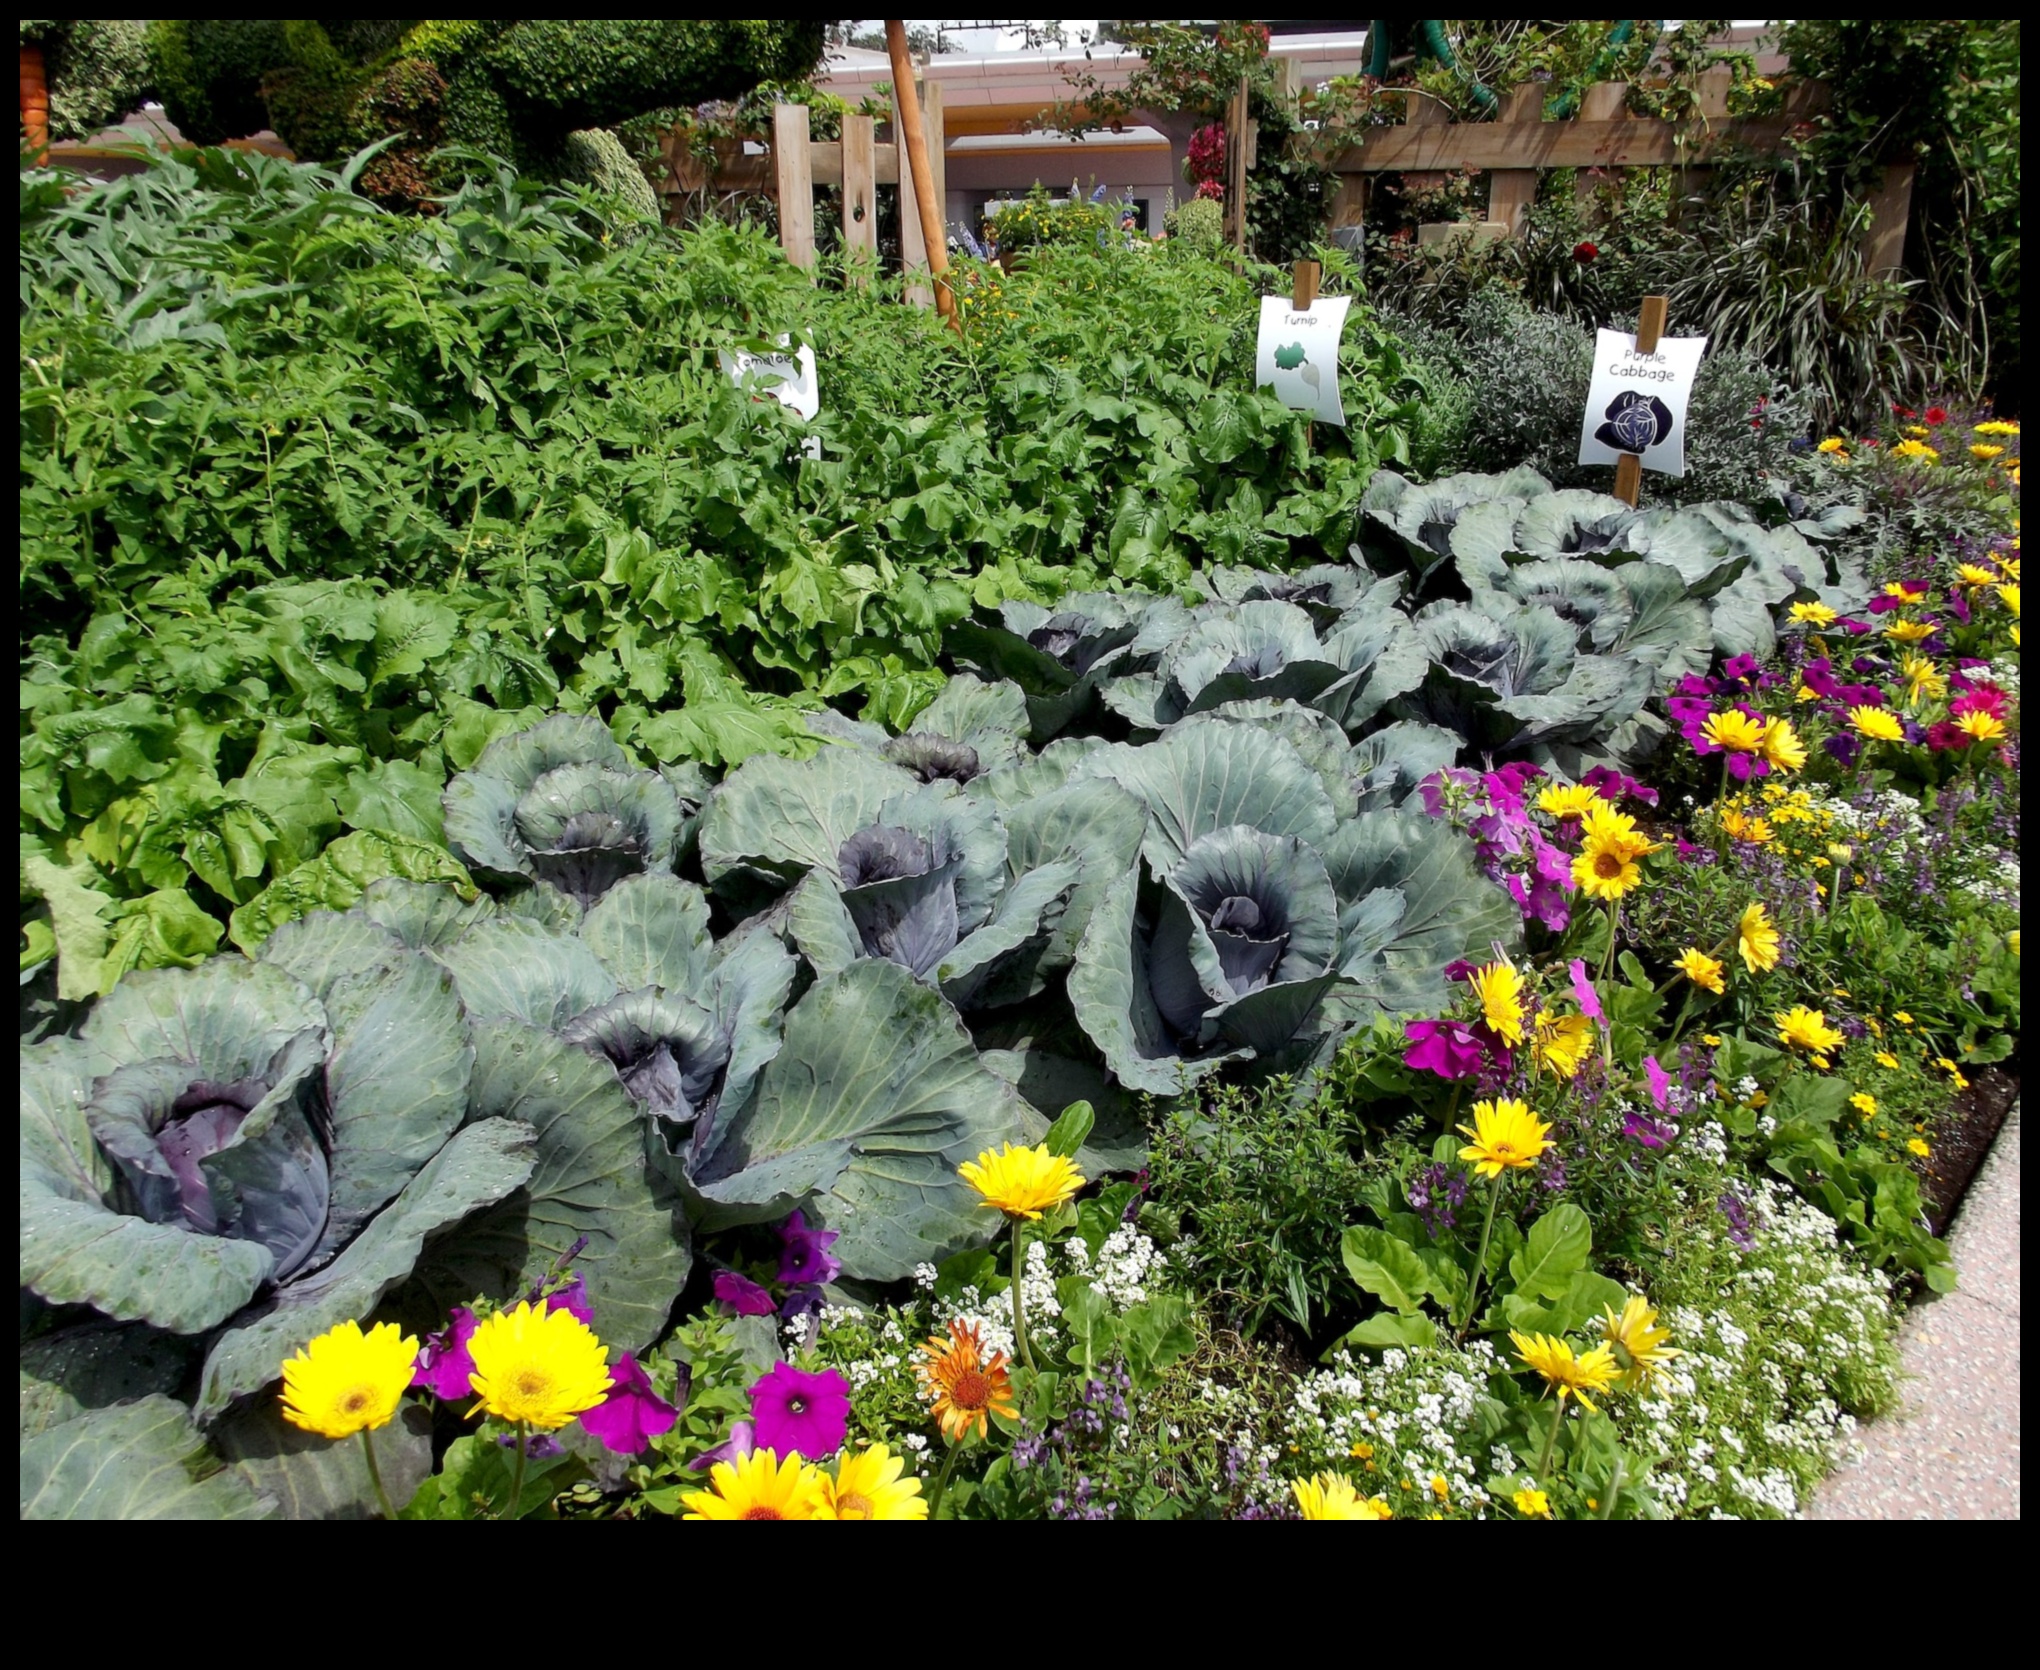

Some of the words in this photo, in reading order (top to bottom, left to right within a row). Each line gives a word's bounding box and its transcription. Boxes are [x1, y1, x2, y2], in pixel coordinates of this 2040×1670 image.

[1284, 314, 1318, 326] Turnip
[738, 354, 793, 368] omatoe
[1624, 349, 1666, 364] Purple
[1609, 363, 1675, 383] Cabbage
